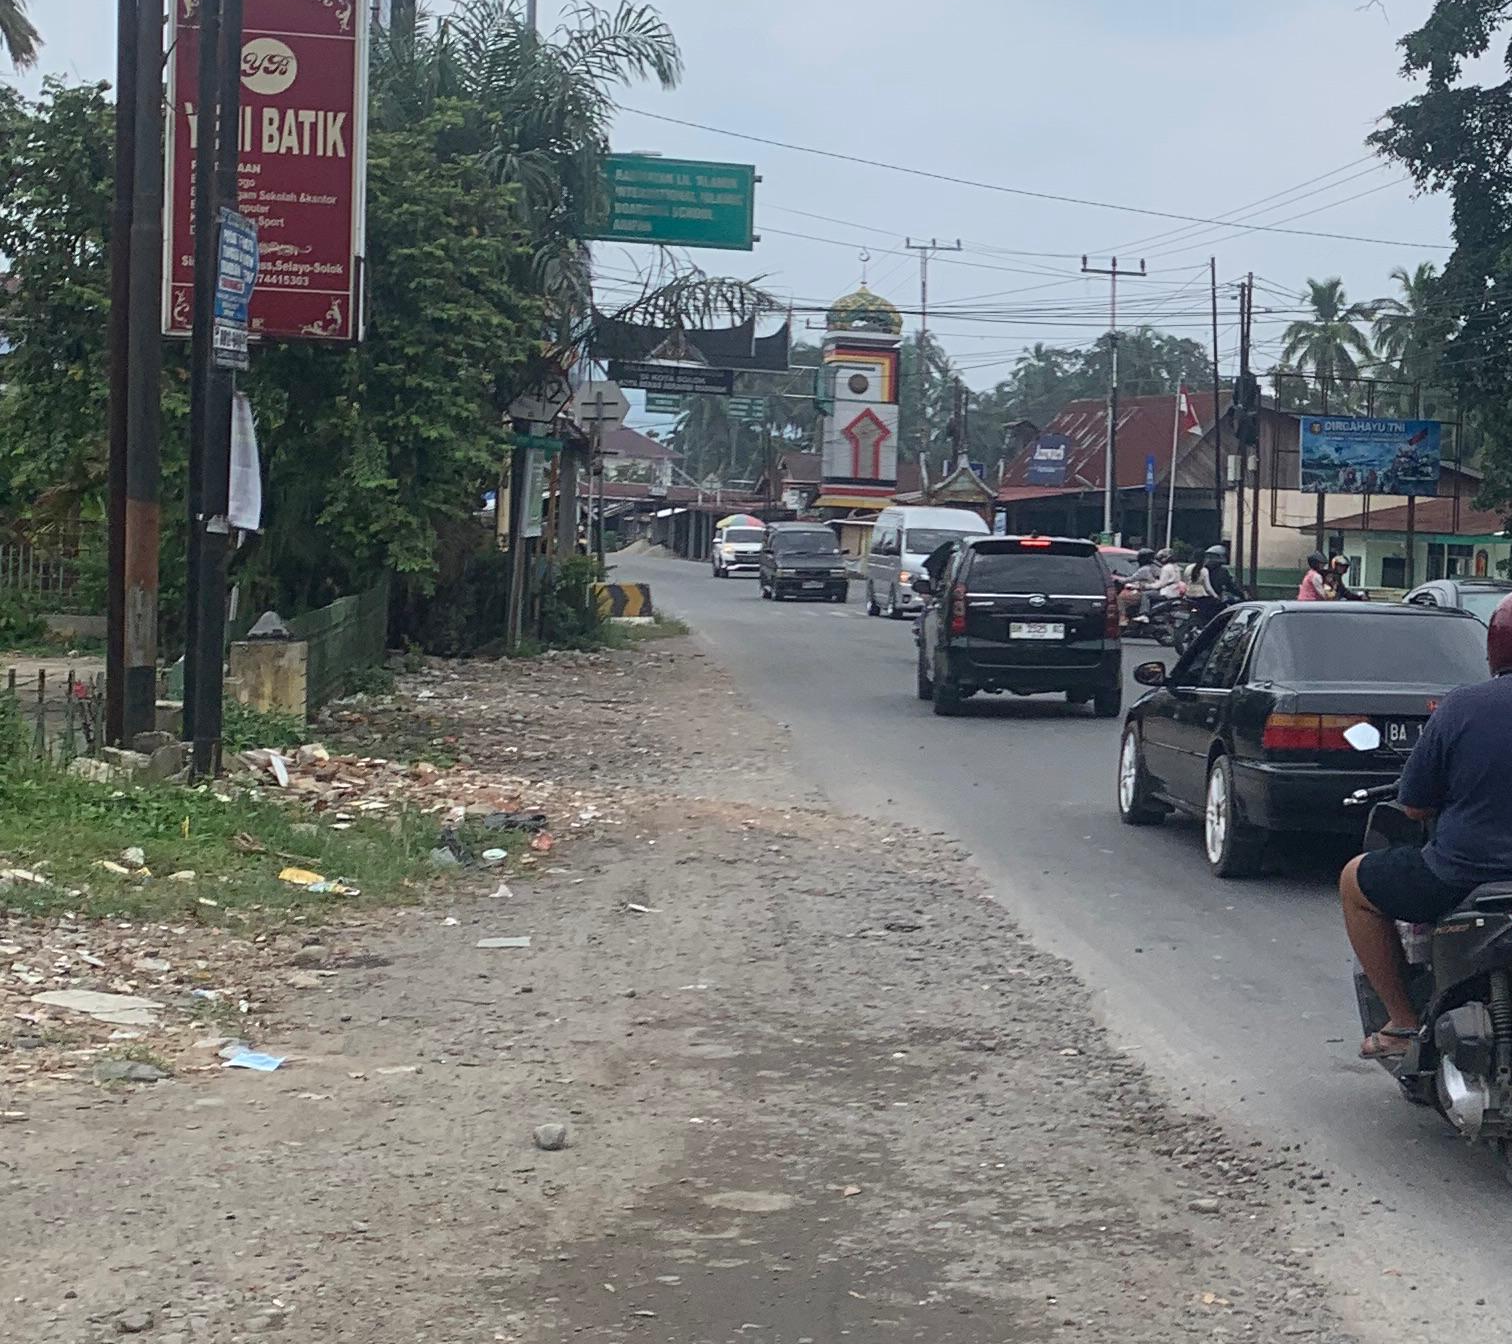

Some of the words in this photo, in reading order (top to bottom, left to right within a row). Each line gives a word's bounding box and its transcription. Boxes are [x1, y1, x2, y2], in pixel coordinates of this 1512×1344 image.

[184, 101, 252, 153] YI
[262, 106, 346, 158] BATIK
[258, 215, 285, 227] Sport
[1390, 723, 1407, 741] BA
